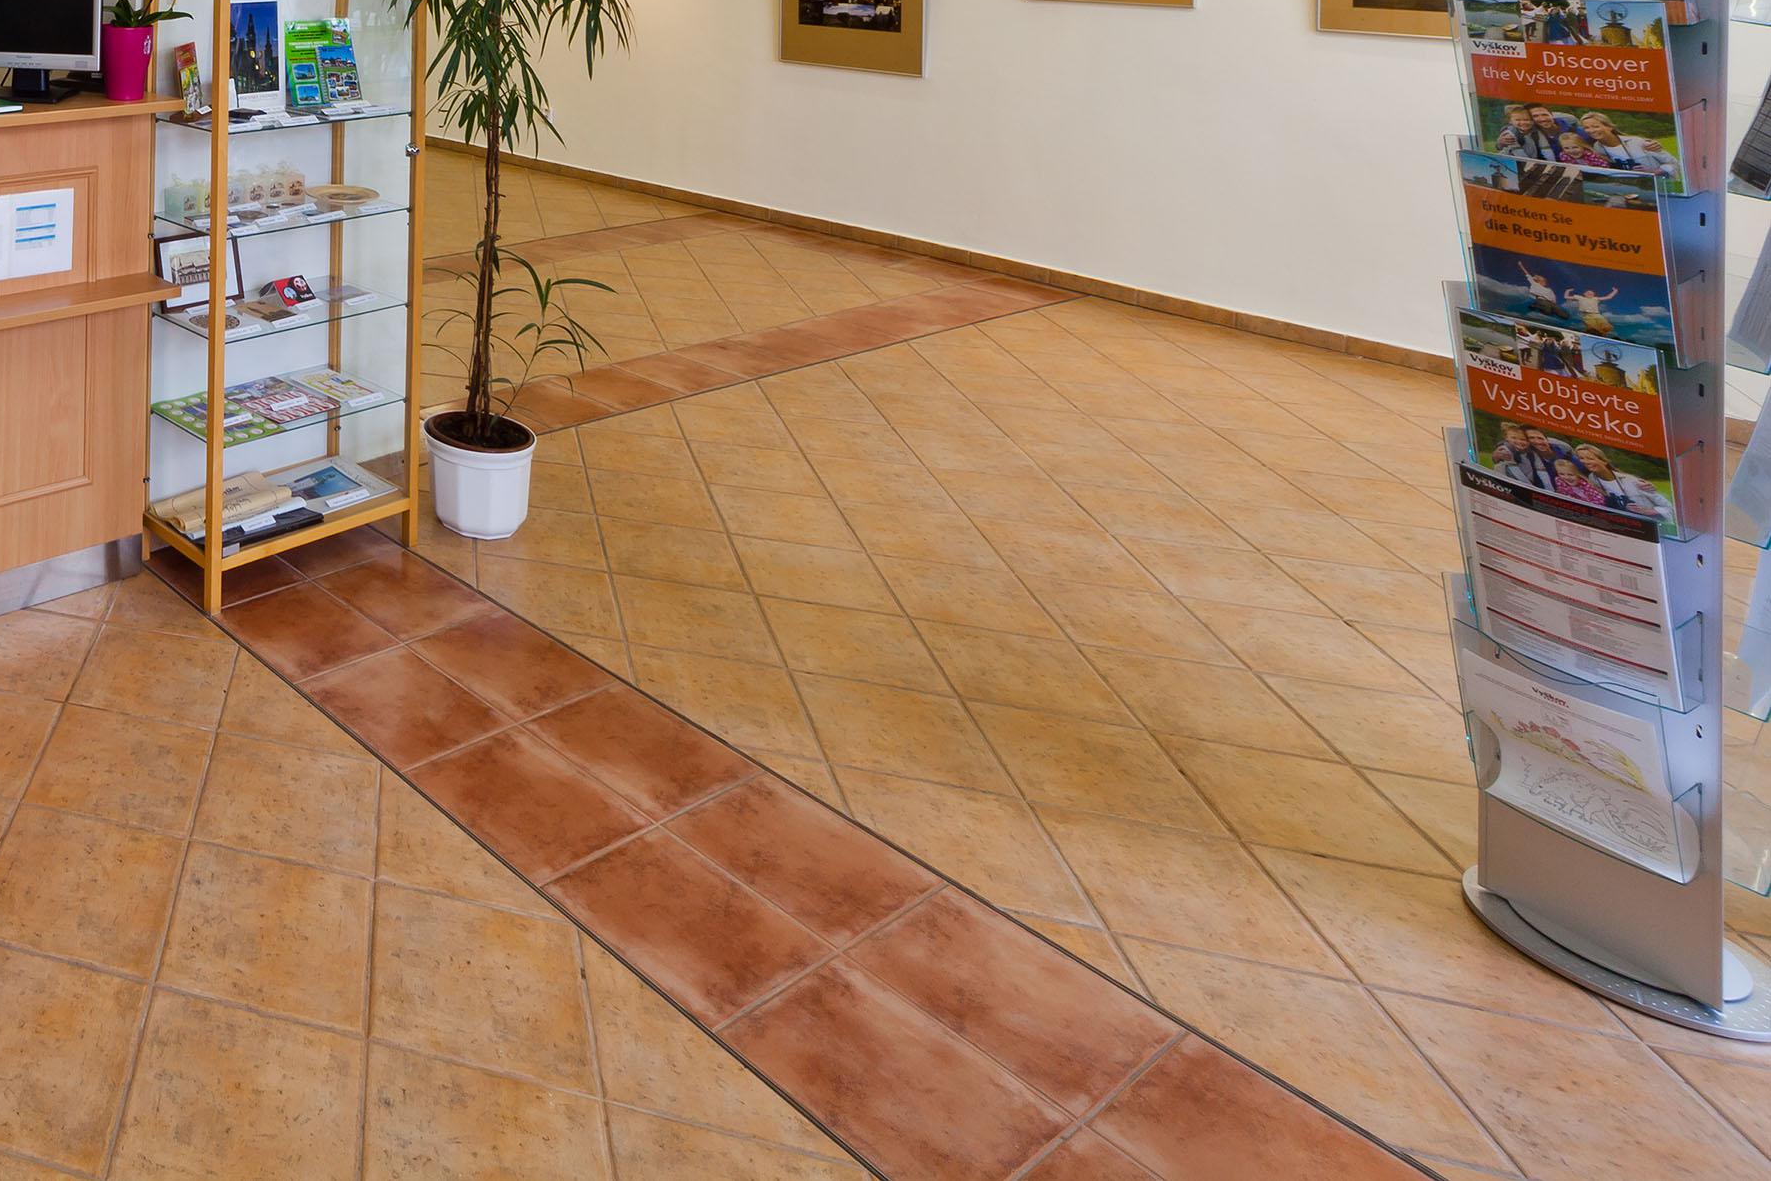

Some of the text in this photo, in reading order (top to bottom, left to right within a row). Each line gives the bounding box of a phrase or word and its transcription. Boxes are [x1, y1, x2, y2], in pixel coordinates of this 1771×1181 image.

[1472, 39, 1518, 52] Vyškov
[1542, 50, 1650, 73] Discover
[1482, 66, 1651, 92] the Vyškov region
[1481, 199, 1573, 225] Entdecken Sie
[1484, 218, 1642, 255] die Region Vyškov
[1469, 352, 1514, 372] Vyškov
[1538, 376, 1641, 415] Objevte
[1481, 379, 1644, 439] Vyškovsko
